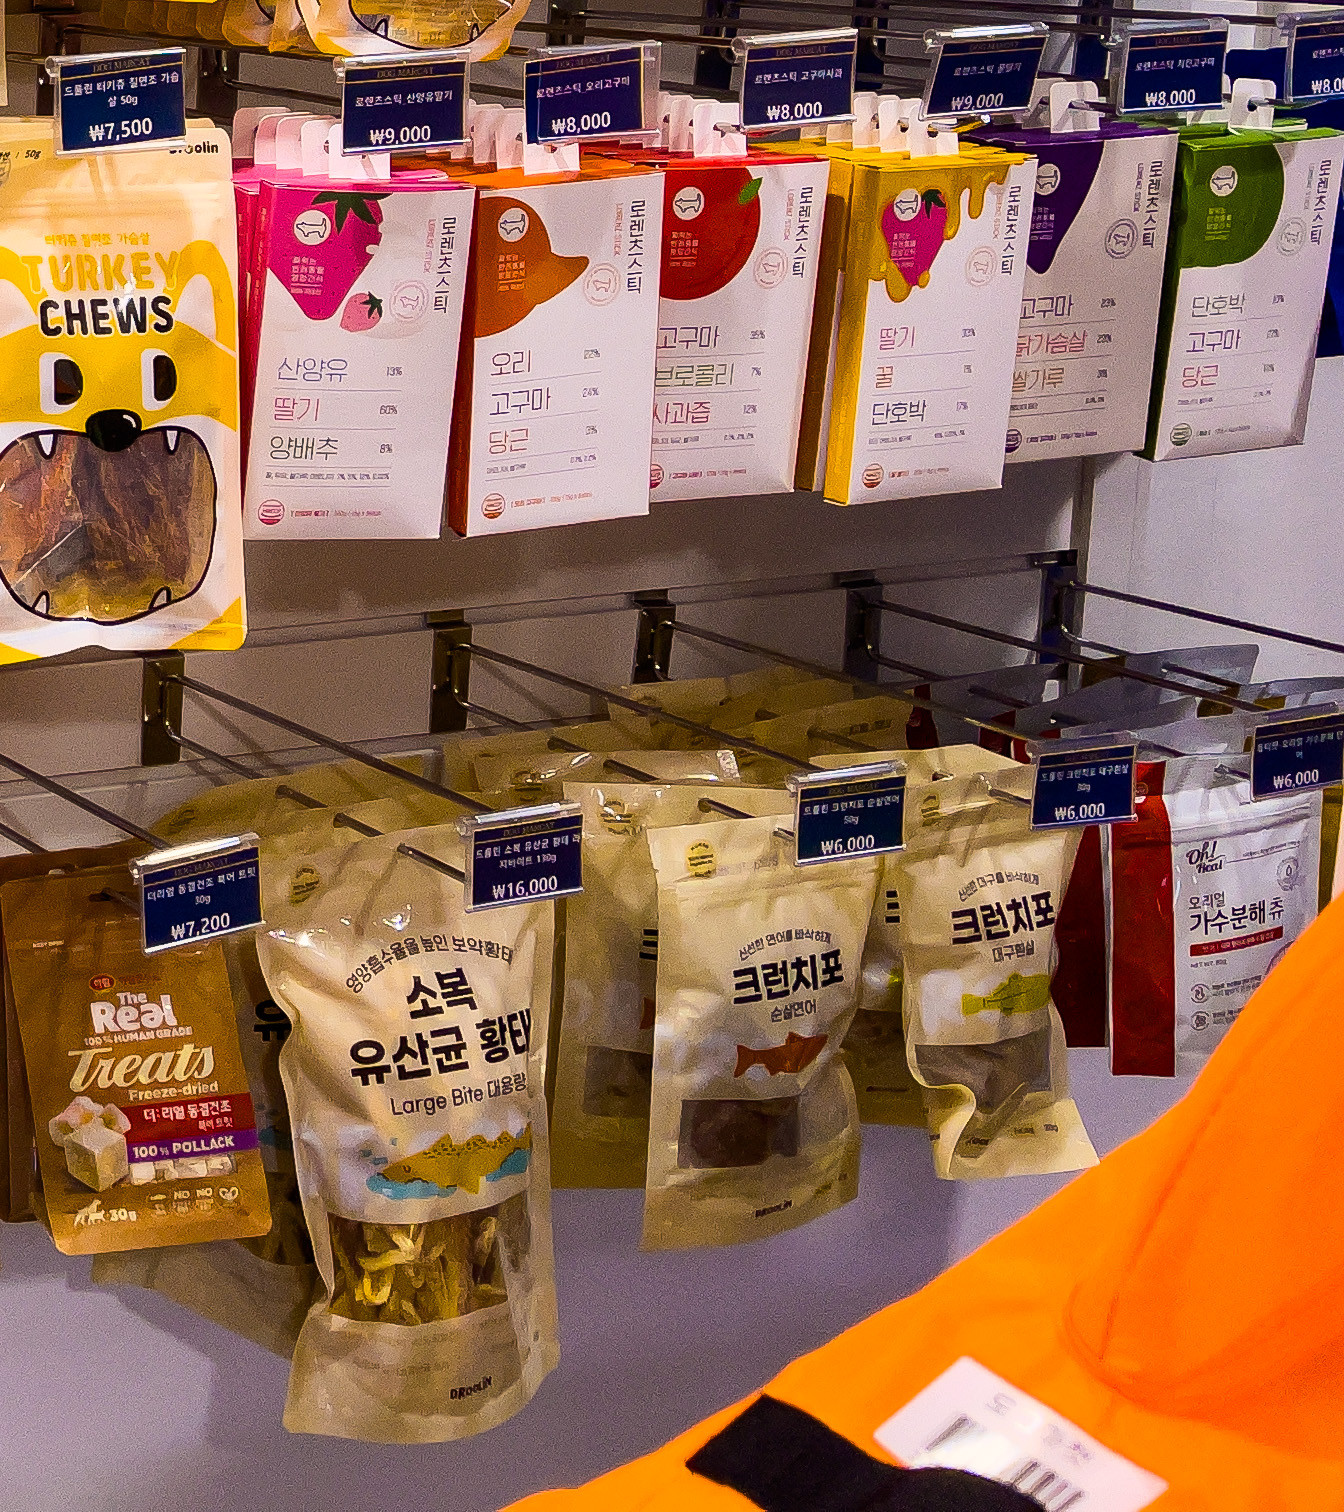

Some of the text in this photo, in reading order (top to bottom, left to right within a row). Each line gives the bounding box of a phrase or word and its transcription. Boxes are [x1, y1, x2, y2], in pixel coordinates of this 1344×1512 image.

[40, 296, 175, 336] CHEWS
[276, 356, 348, 382] 산양유
[491, 351, 531, 376] 오리
[490, 387, 551, 418] 고구마
[872, 399, 926, 425] 단호박
[269, 436, 339, 461] 양배추
[951, 891, 1056, 945] 크런치포
[733, 950, 844, 1004] 크런치포
[119, 991, 148, 1005] The
[407, 968, 477, 1020] 소복
[90, 995, 177, 1034] Real
[349, 1026, 469, 1085] 유산균
[391, 1087, 483, 1117] Large Bite
